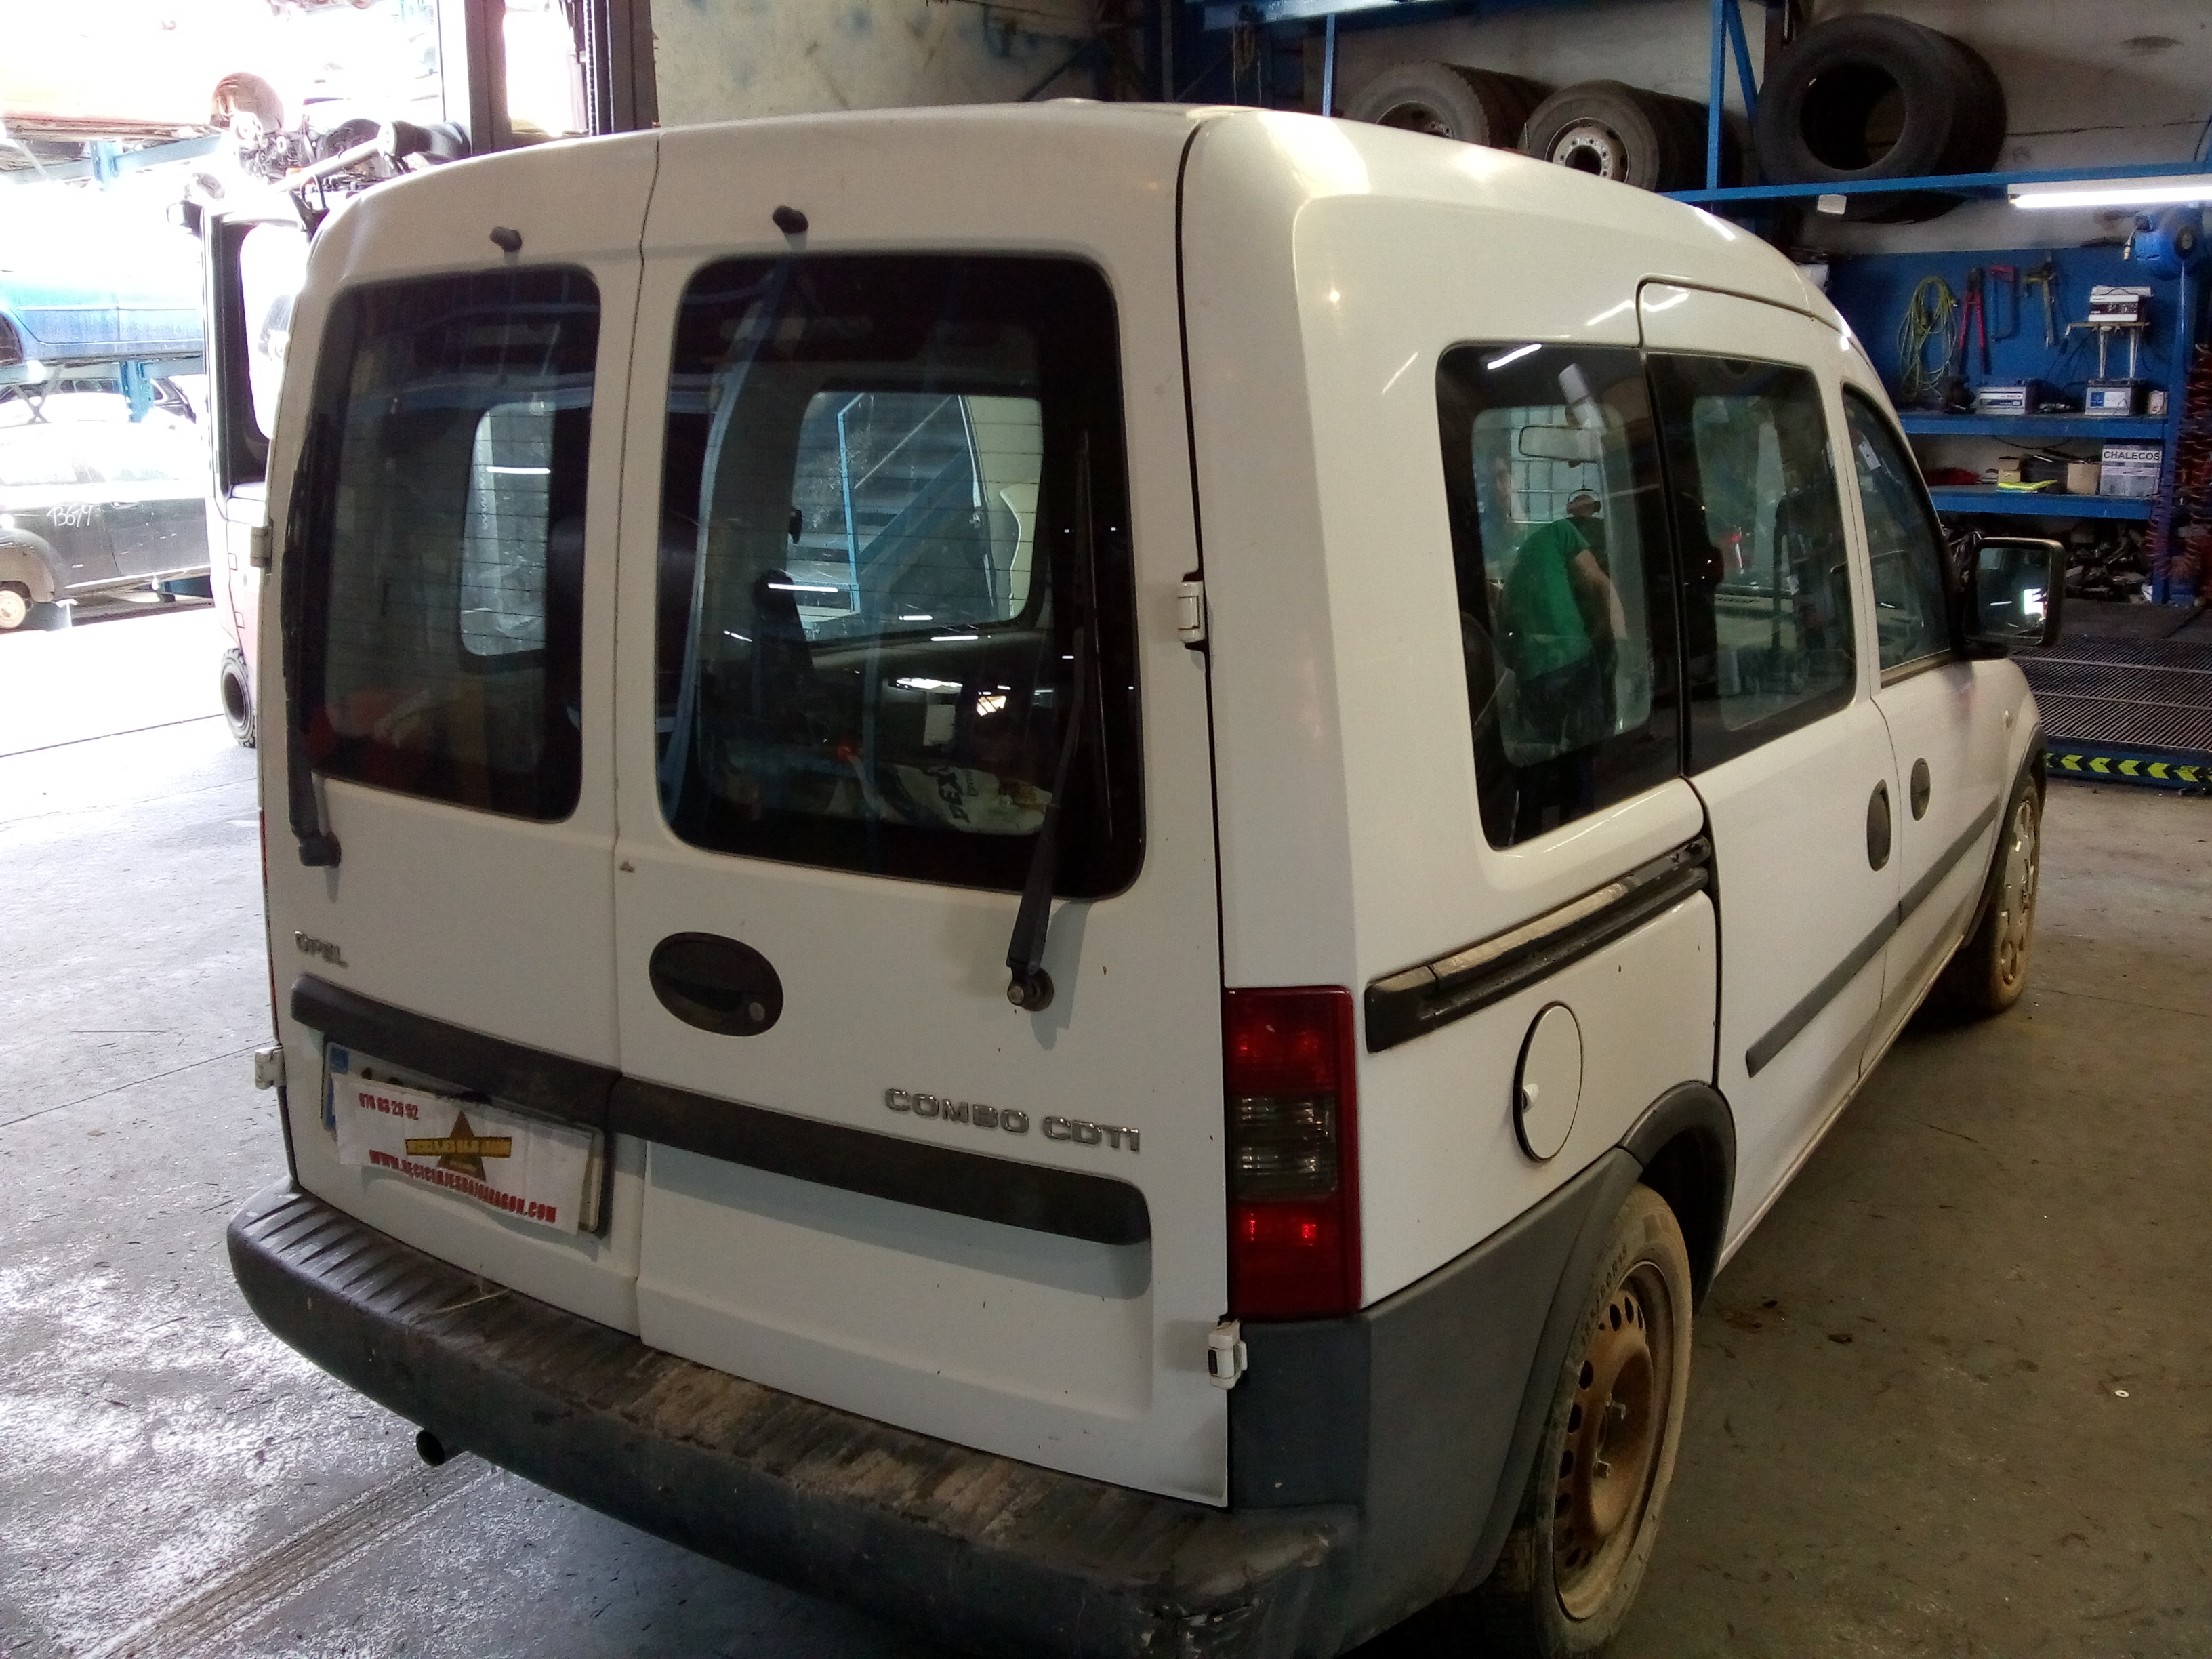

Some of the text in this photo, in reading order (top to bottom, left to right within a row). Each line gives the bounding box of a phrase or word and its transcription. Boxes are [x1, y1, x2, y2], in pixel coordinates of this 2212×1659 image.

[2103, 451, 2160, 462] CHALECOS
[884, 1087, 1141, 1153] COMBO CDTI
